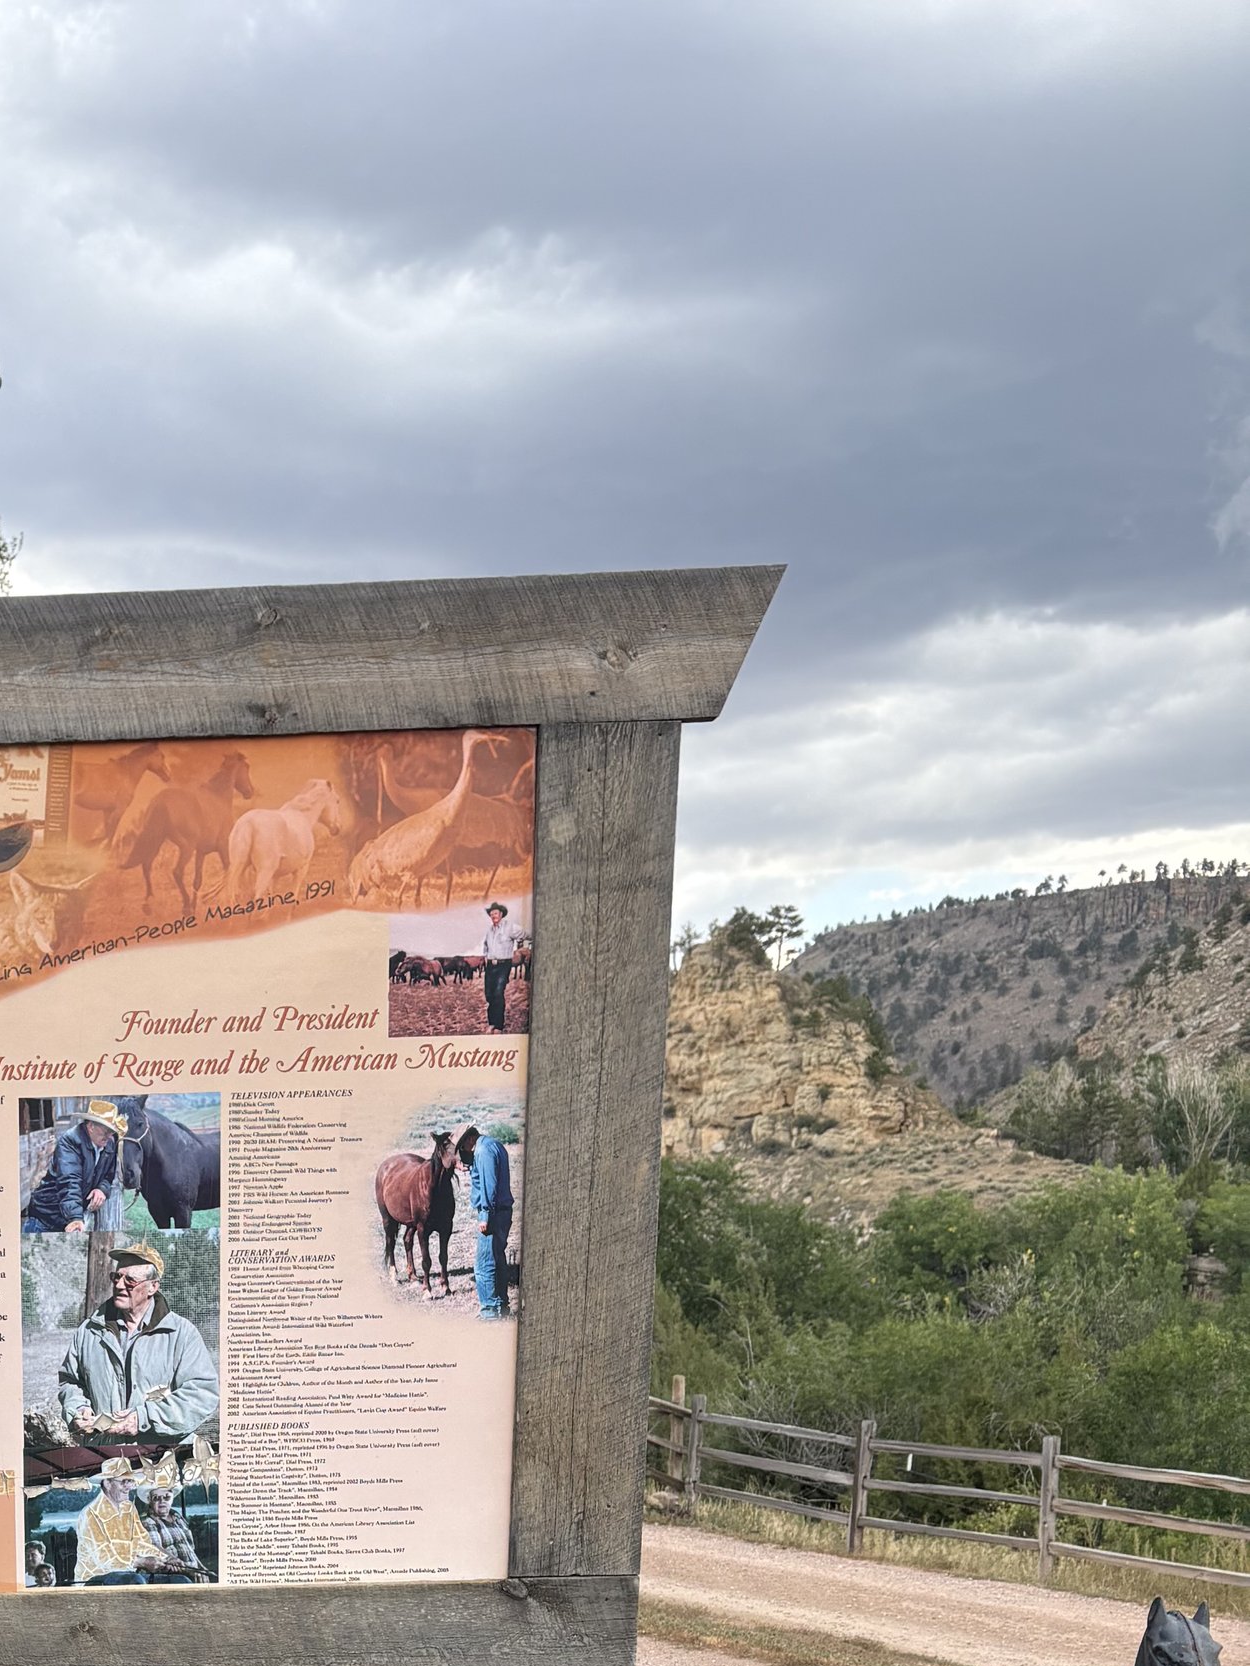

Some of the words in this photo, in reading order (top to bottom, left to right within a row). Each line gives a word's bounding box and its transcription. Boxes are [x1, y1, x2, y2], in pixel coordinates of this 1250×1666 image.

[40, 914, 198, 970] American-People
[205, 891, 301, 923] Magazine,
[305, 880, 336, 899] 1991
[116, 1009, 217, 1042] Founder
[222, 1007, 266, 1032] and
[273, 1004, 379, 1032] President
[84, 1053, 108, 1084] of
[113, 1052, 184, 1086] Range
[190, 1050, 234, 1076] and
[238, 1048, 270, 1074] the
[276, 1046, 398, 1073] American
[405, 1043, 518, 1072] Mustang
[231, 1091, 284, 1099] TELEVISION
[286, 1090, 353, 1098] APPEARANCES
[228, 1256, 298, 1264] CONSERVATION
[299, 1254, 335, 1262] AWARDS
[230, 1249, 274, 1257] LITERARY
